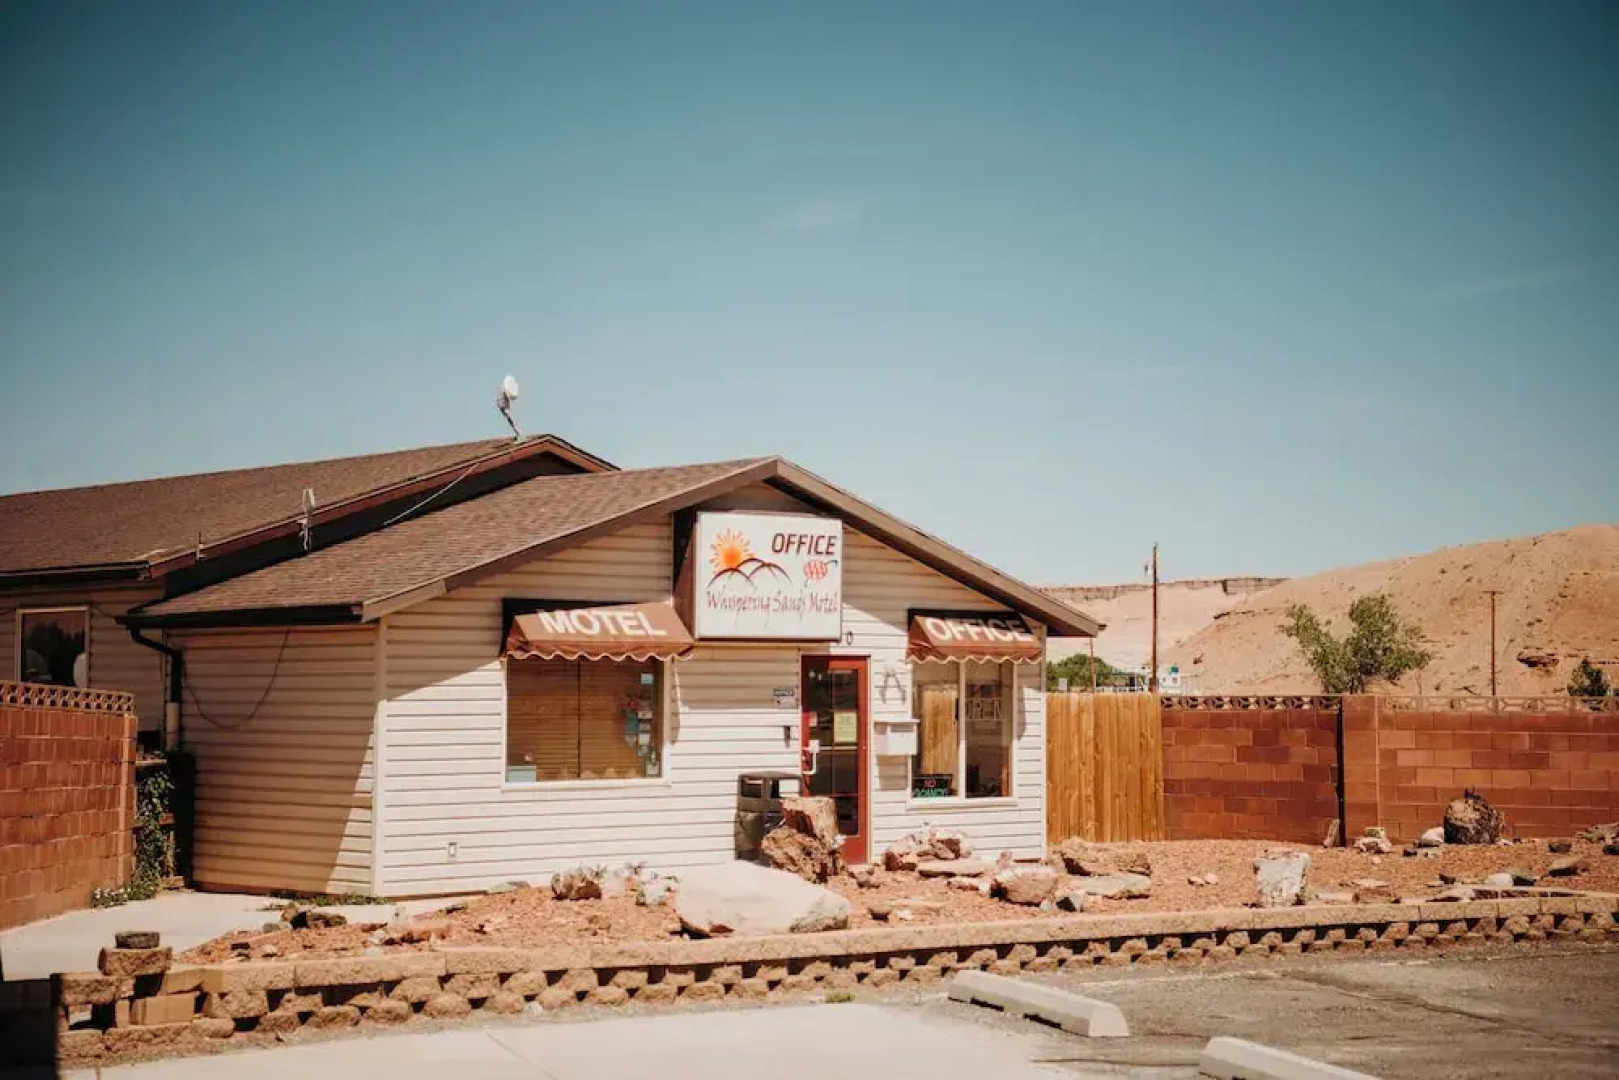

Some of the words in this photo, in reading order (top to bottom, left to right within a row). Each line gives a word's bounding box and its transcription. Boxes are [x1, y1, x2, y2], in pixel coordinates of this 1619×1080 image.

[771, 532, 838, 555] OFFICE
[809, 591, 838, 613] Motel
[537, 608, 668, 637] MOTEL
[924, 616, 1035, 642] OFFICE
